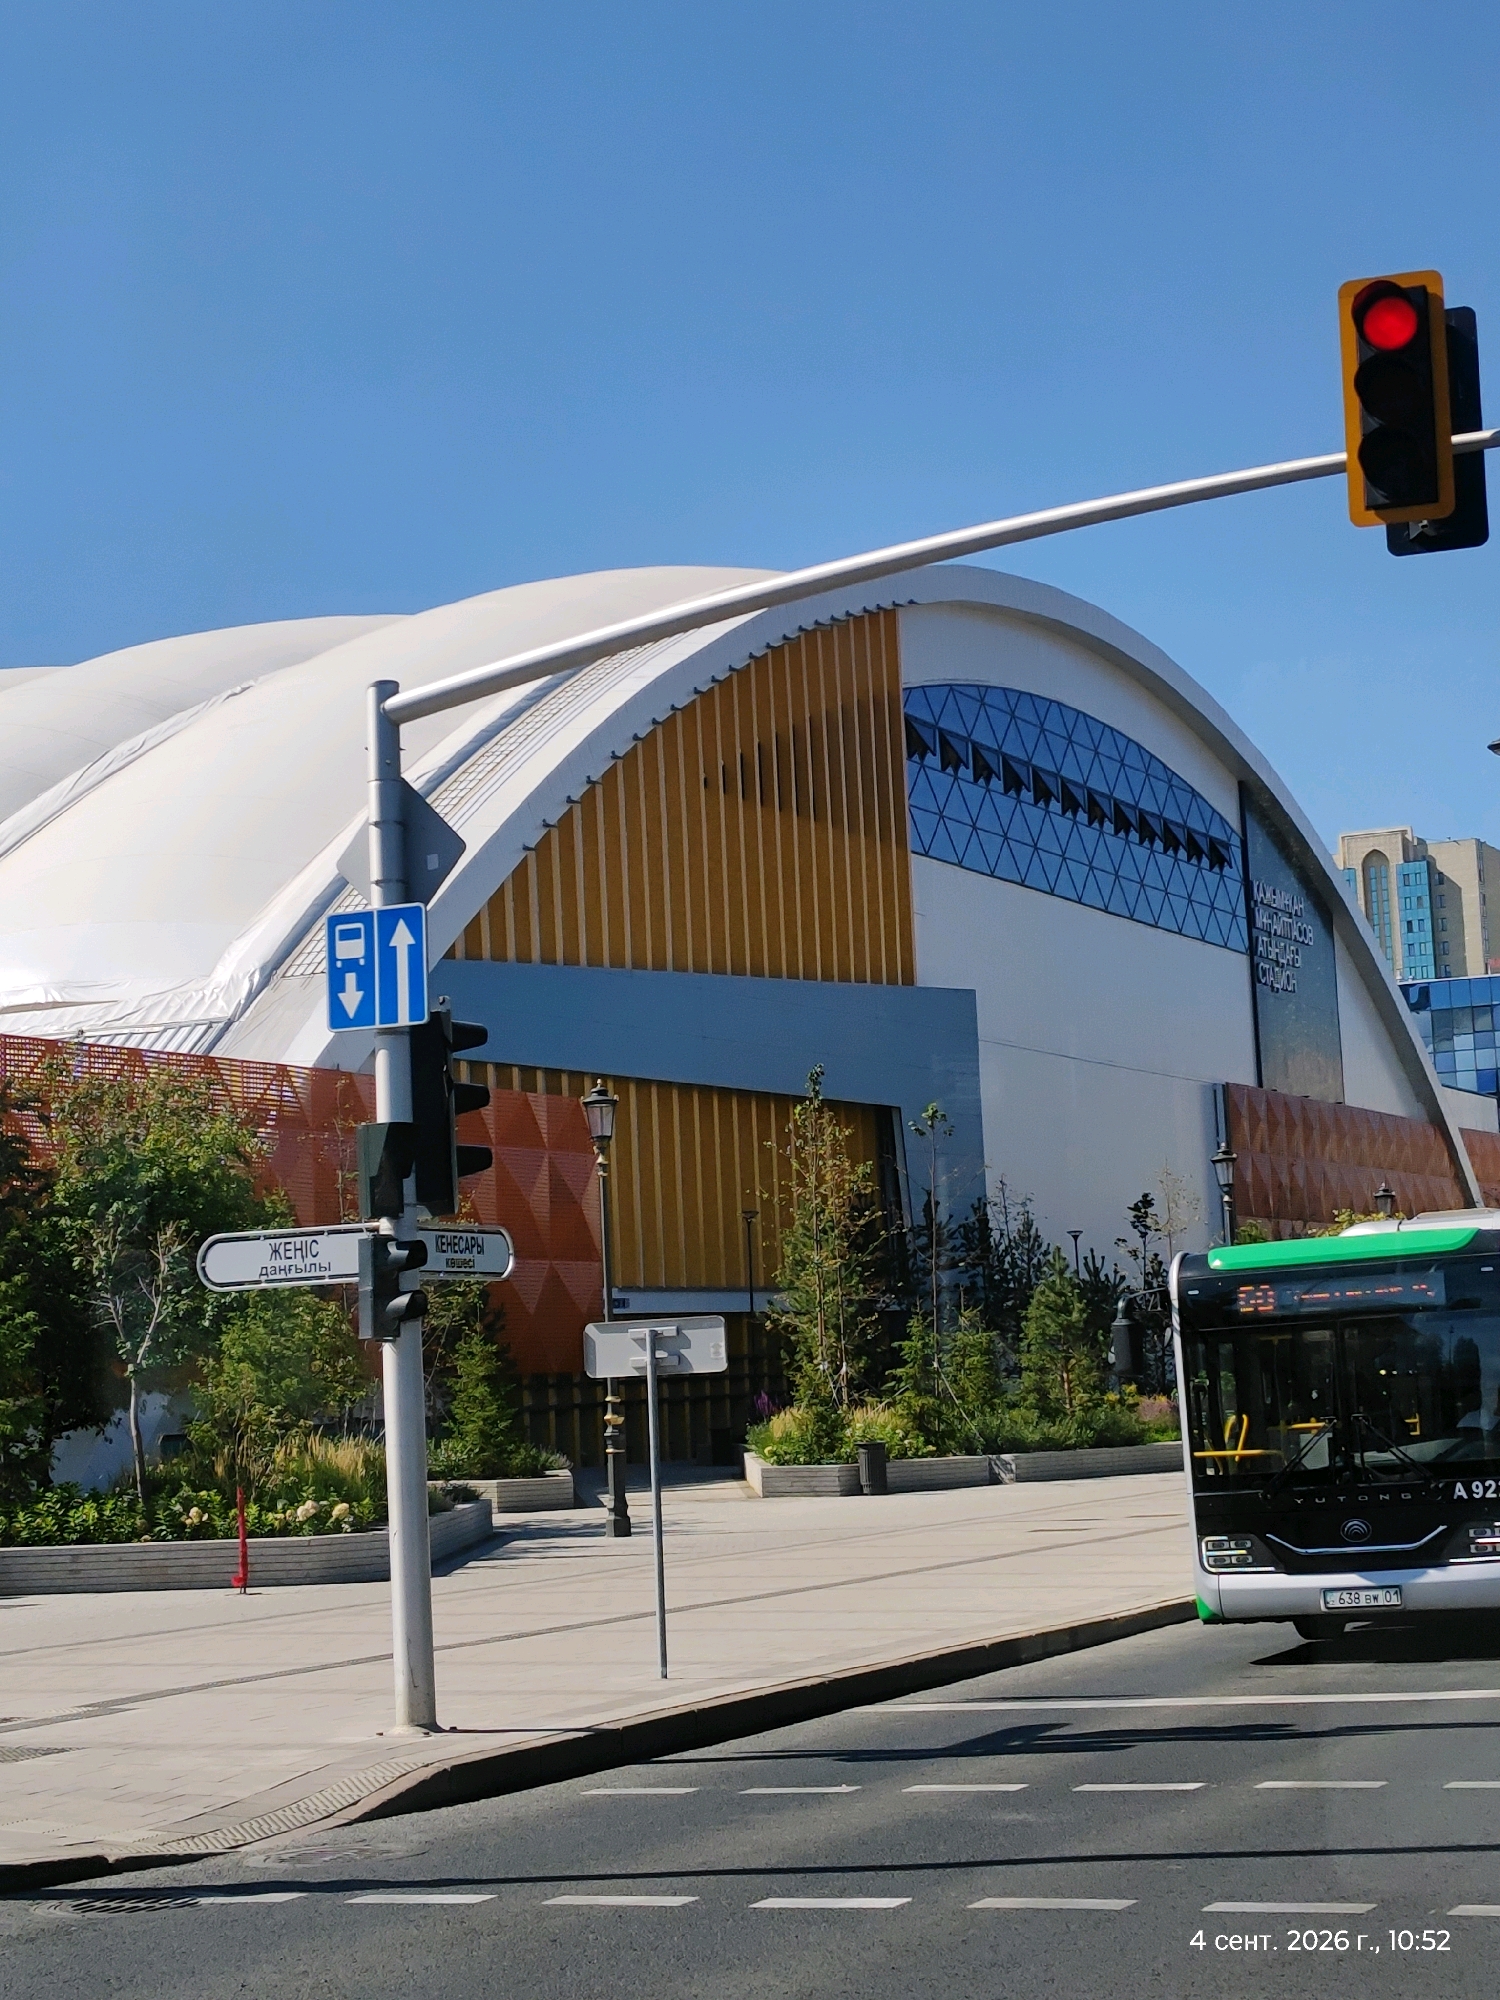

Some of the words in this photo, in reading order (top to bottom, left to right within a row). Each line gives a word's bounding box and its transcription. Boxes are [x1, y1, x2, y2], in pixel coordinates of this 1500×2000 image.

[1258, 961, 1297, 993] СТАДИОН
[268, 1239, 319, 1263] ЖЕҢІС
[434, 1234, 485, 1255] КЕНЕСАРЫ
[258, 1262, 332, 1279] даңғылы
[1294, 1492, 1412, 1504] YUTONG
[1471, 1480, 1500, 1499] 92
[1338, 1591, 1361, 1605] 638
[1364, 1593, 1380, 1604] BW
[1384, 1590, 1400, 1603] 01
